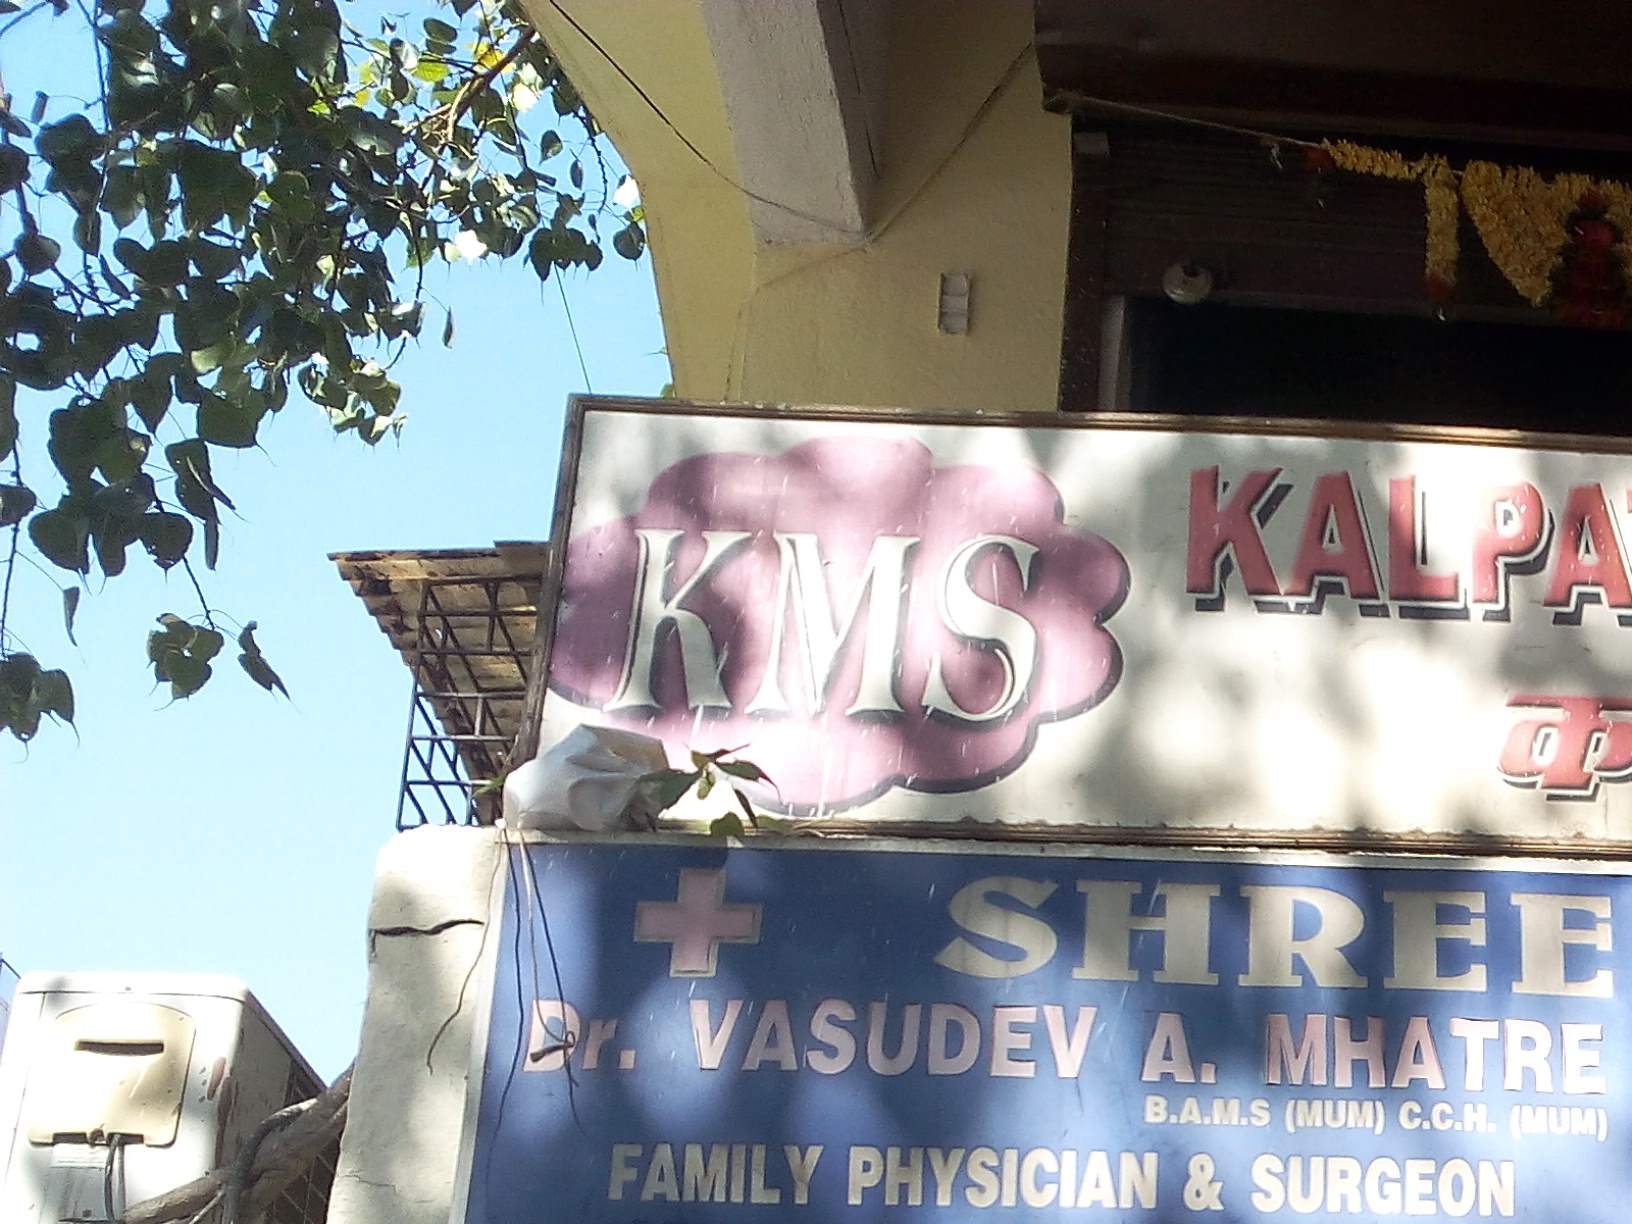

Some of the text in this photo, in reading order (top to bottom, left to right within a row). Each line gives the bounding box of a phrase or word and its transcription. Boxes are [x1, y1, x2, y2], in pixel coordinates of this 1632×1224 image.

[605, 527, 1039, 722] KMS
[934, 875, 1614, 999] SHREE
[523, 998, 1608, 1096] Dr. VASUDEV A. MHATRE
[1144, 1095, 1608, 1143] B.A.M.S (MUM) C.C.H. (MUM)
[607, 1143, 1515, 1217] FAMILY PHYSICIAN & SURGEON
